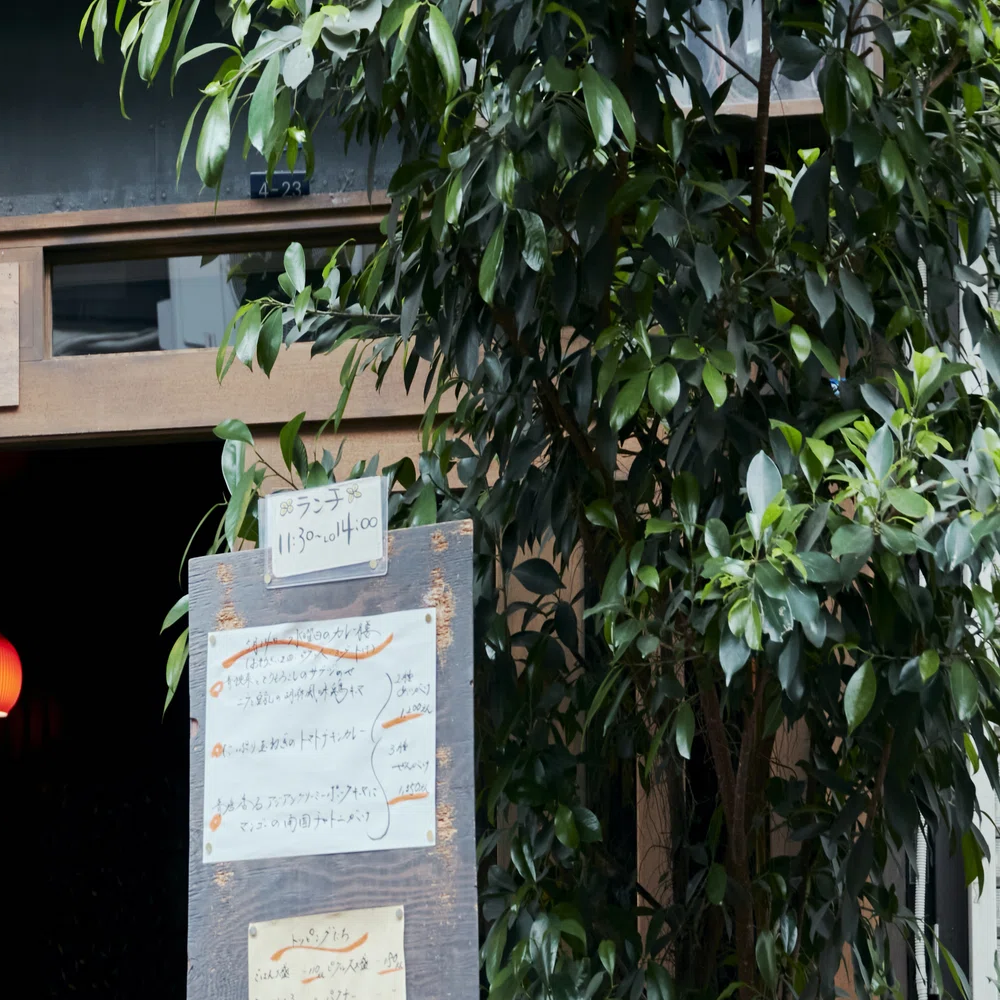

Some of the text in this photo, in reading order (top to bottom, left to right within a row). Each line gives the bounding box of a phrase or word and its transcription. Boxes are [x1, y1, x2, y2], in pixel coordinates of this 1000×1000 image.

[258, 180, 302, 198] 4-23
[297, 488, 344, 520] ランチ
